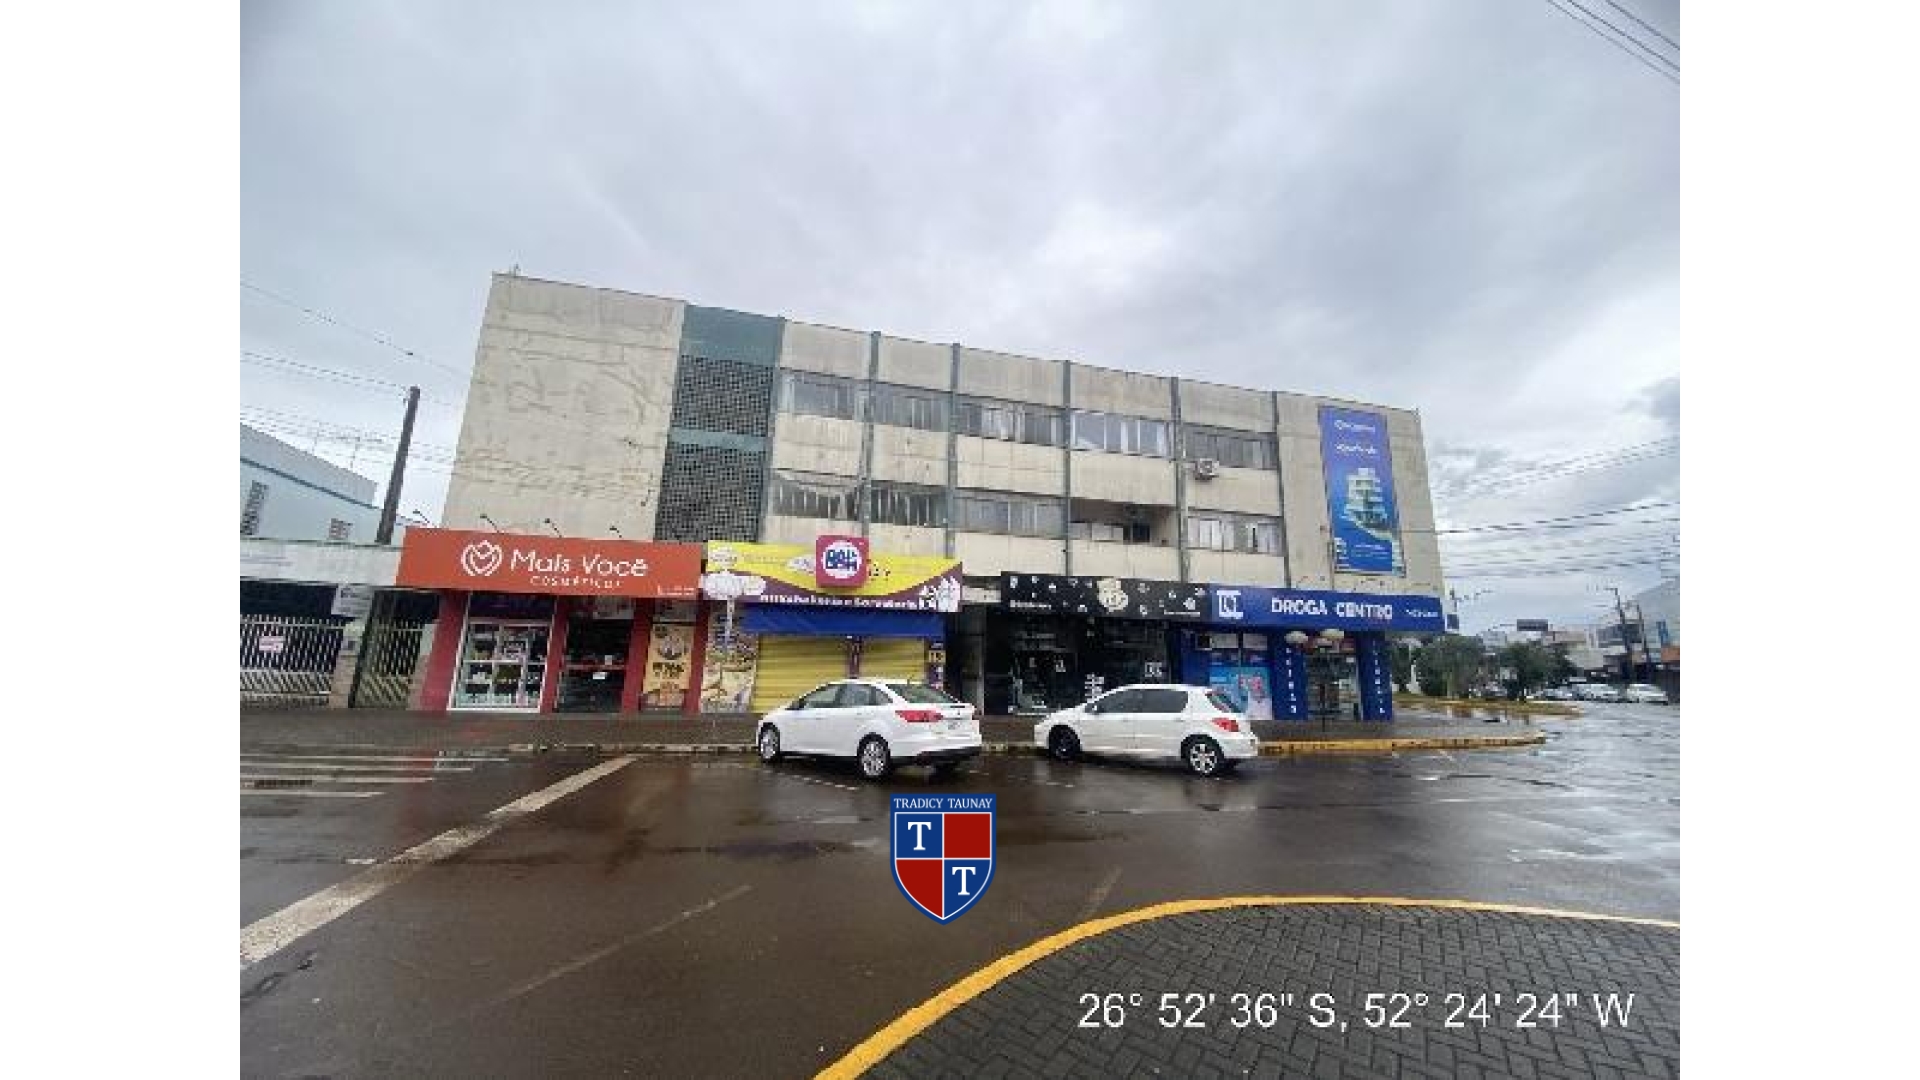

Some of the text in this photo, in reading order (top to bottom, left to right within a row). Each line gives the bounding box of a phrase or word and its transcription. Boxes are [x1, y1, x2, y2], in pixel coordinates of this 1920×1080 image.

[511, 549, 649, 577] Mais Você
[1271, 596, 1328, 615] DROGA
[1335, 601, 1393, 620] CENTRO
